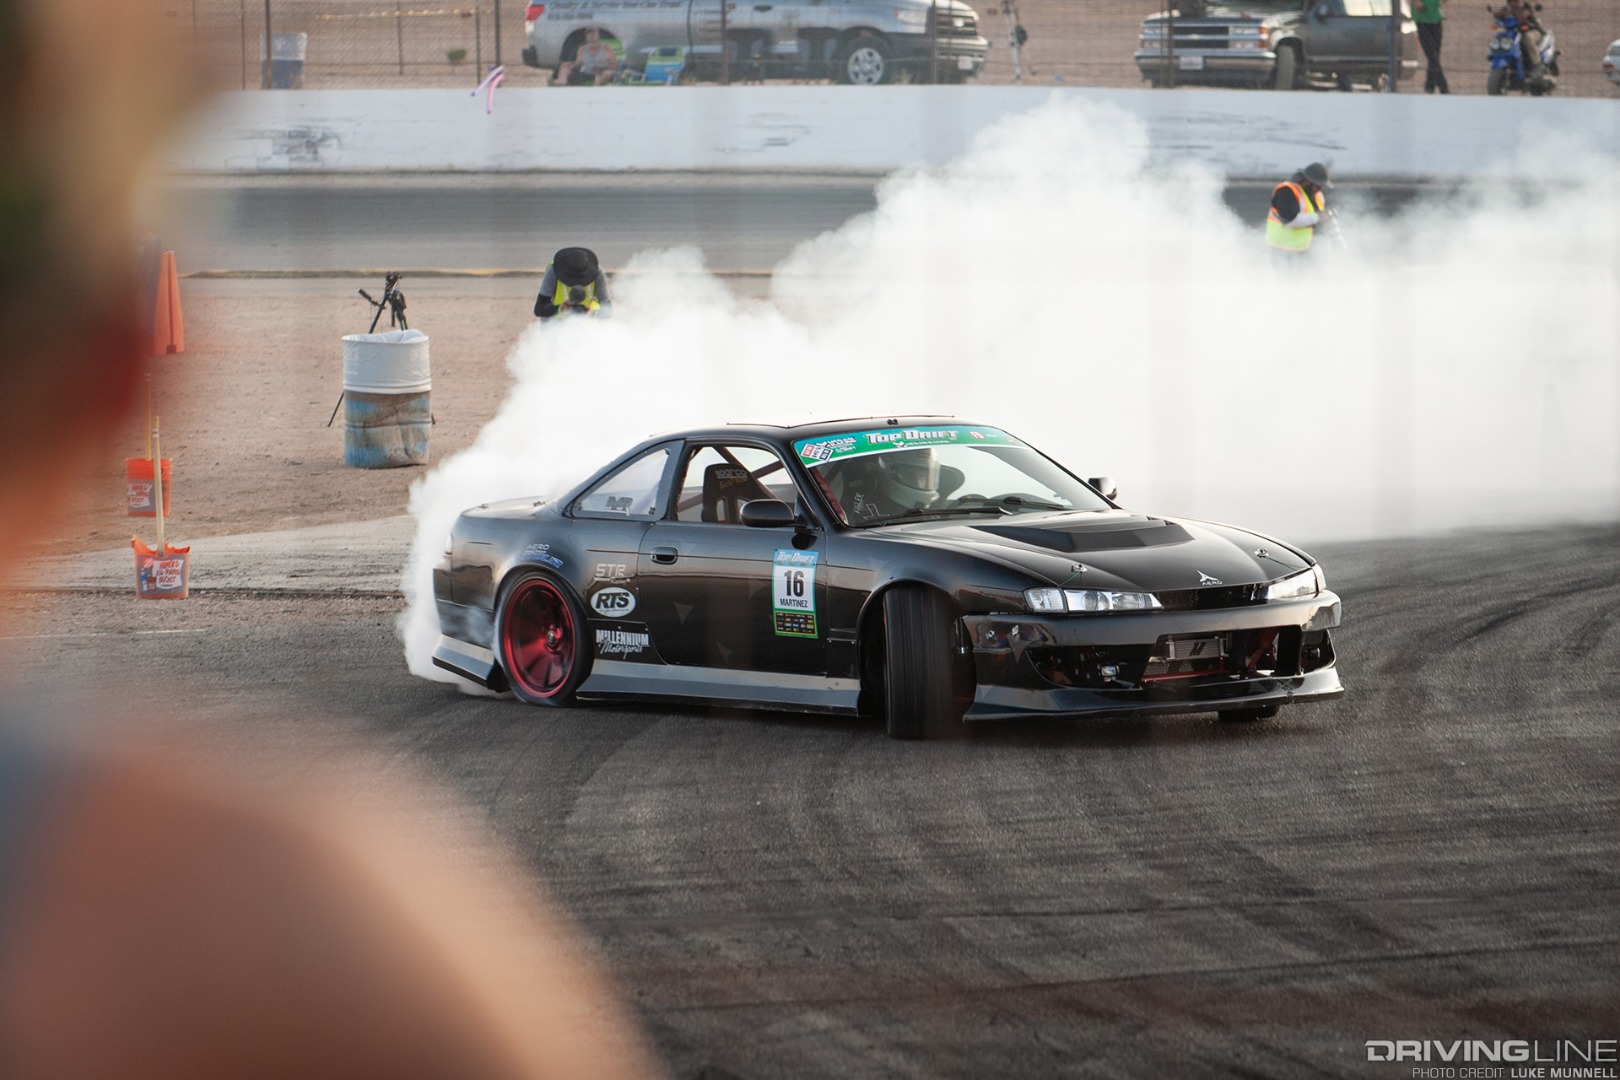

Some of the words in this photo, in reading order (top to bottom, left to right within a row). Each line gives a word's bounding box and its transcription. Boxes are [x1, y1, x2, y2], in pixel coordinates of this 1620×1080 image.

[784, 570, 805, 597] 16
[595, 592, 630, 609] RTS
[780, 598, 808, 608] MARTINEZ
[596, 629, 650, 647] MILLENNIUM
